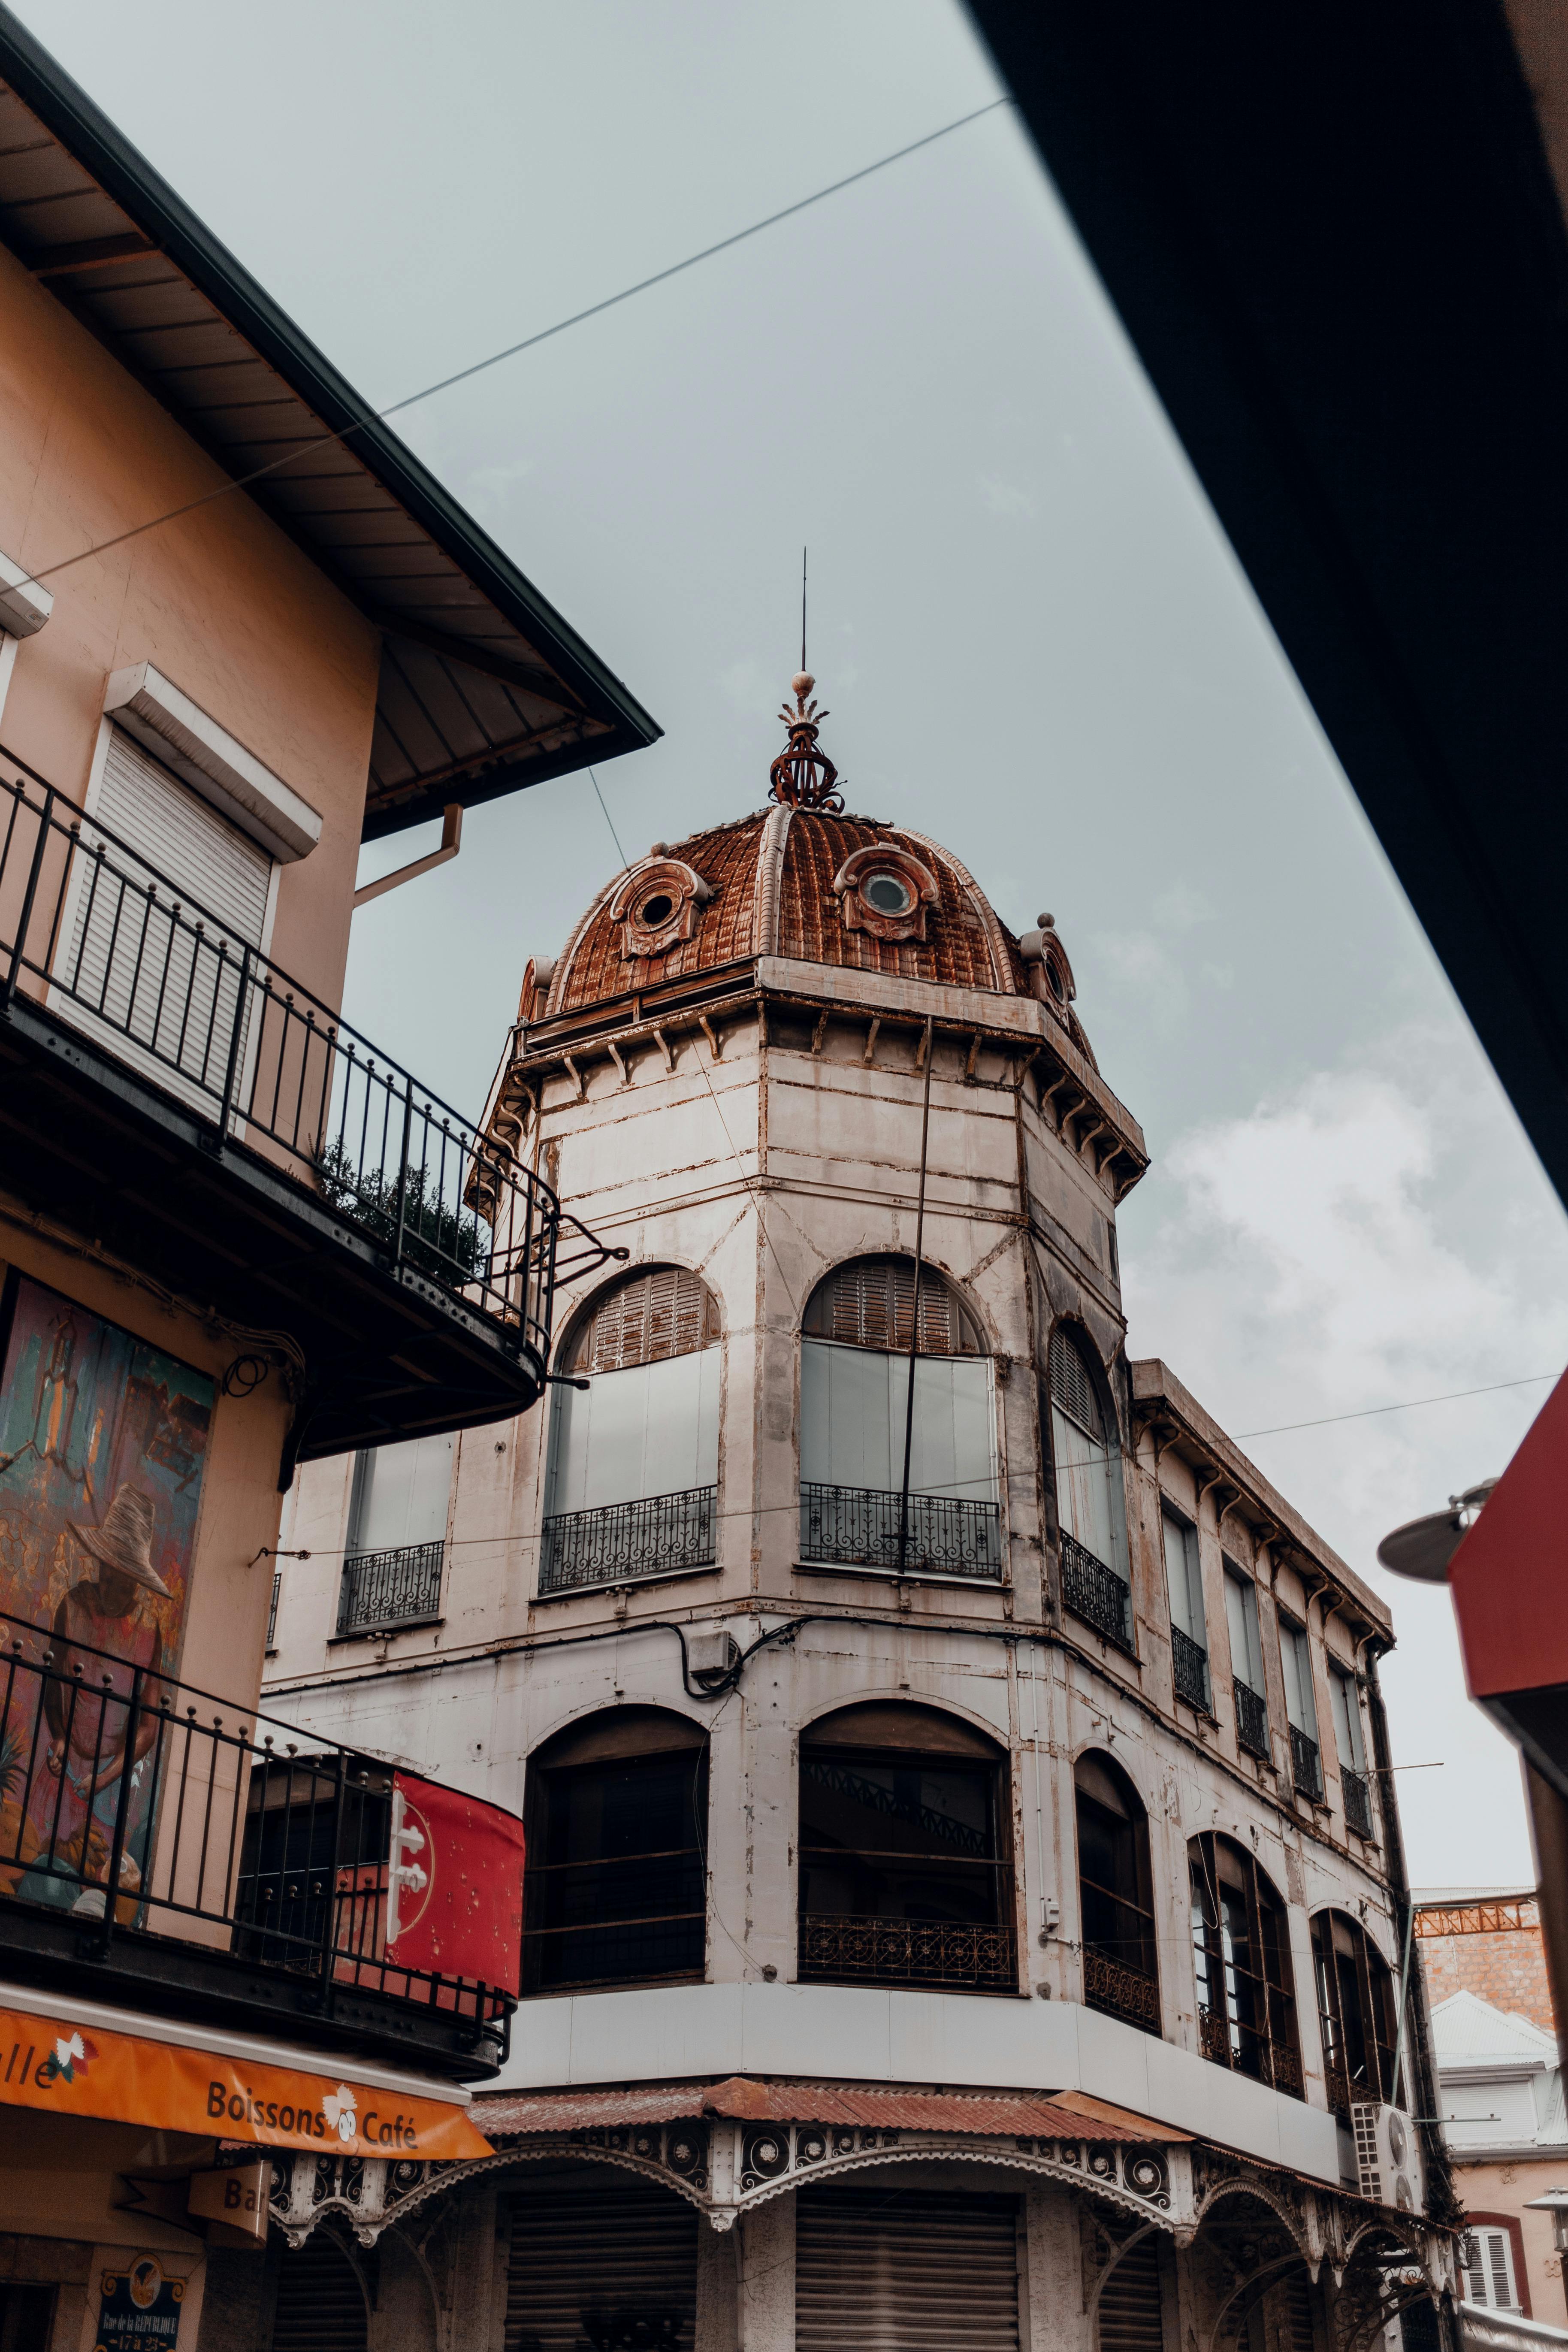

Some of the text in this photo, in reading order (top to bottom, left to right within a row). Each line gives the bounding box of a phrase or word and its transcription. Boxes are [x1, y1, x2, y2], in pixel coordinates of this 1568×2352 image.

[0, 2044, 57, 2089] lle
[207, 2081, 418, 2149] Boissons Café
[225, 2178, 265, 2213] Bar
[103, 2312, 117, 2330] Rue
[118, 2314, 126, 2330] de
[127, 2314, 133, 2331] la
